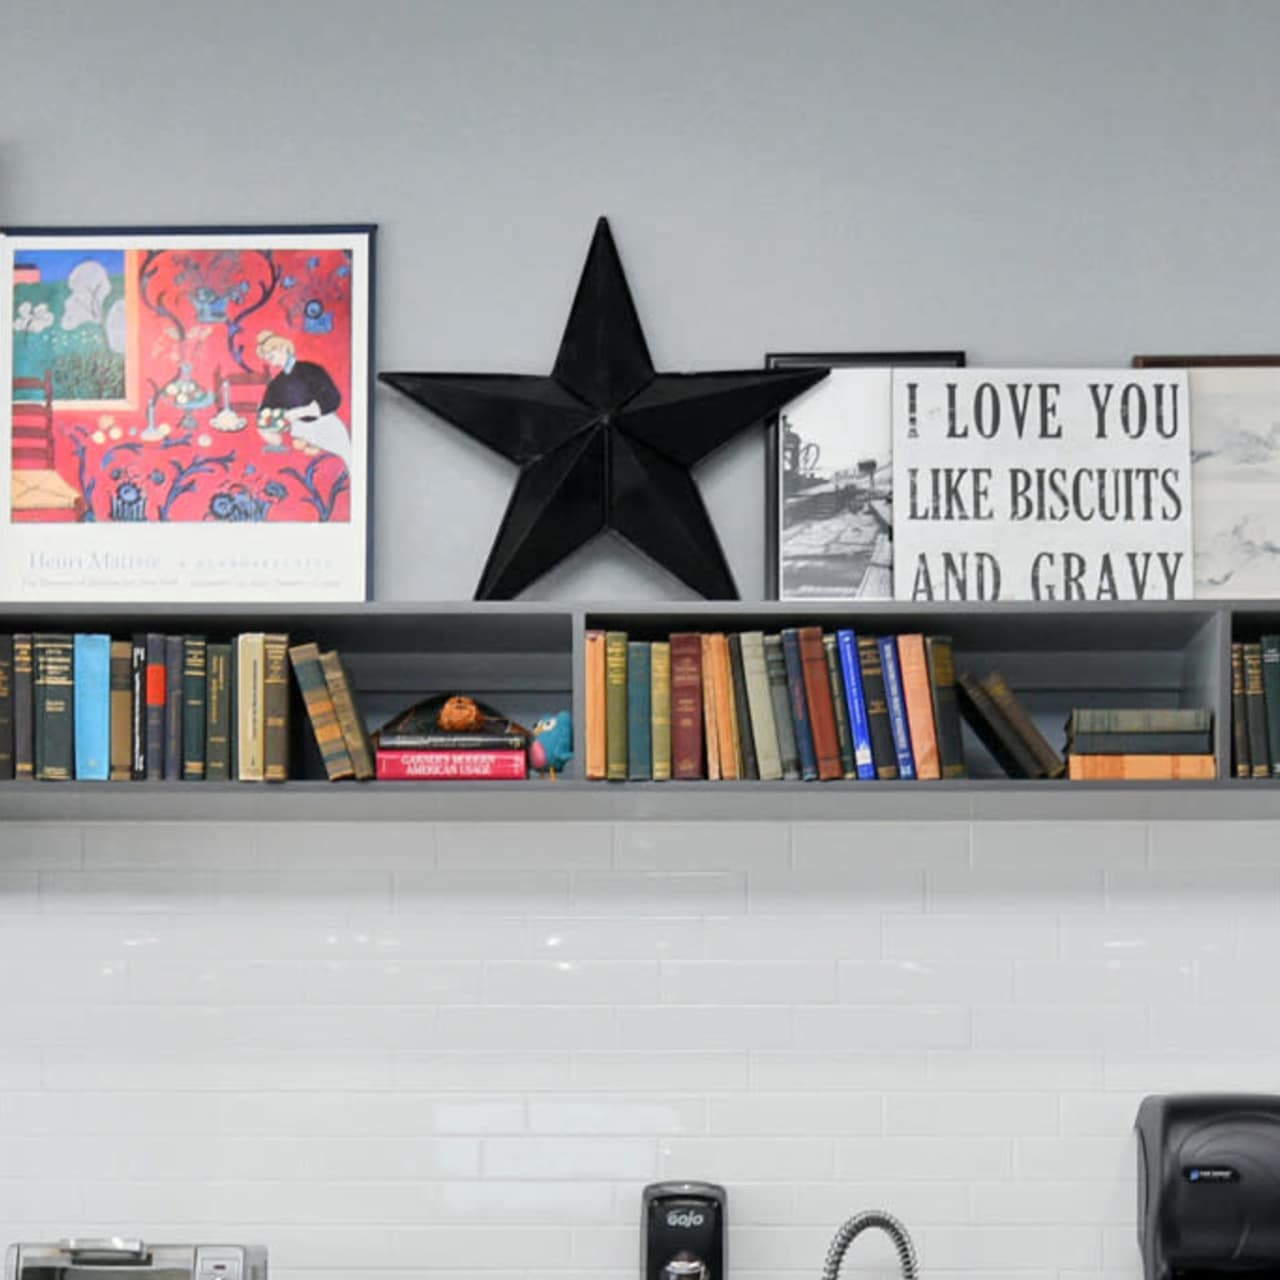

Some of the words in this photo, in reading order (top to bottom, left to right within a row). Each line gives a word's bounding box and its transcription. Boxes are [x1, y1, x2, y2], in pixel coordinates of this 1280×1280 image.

[906, 382, 920, 439] I
[947, 383, 1063, 439] LOVE
[1088, 383, 1179, 439] YOU
[909, 468, 994, 521] LIKE
[1010, 468, 1182, 522] BISCUITS
[911, 551, 1002, 601] AND
[1031, 551, 1183, 601] GRAVY
